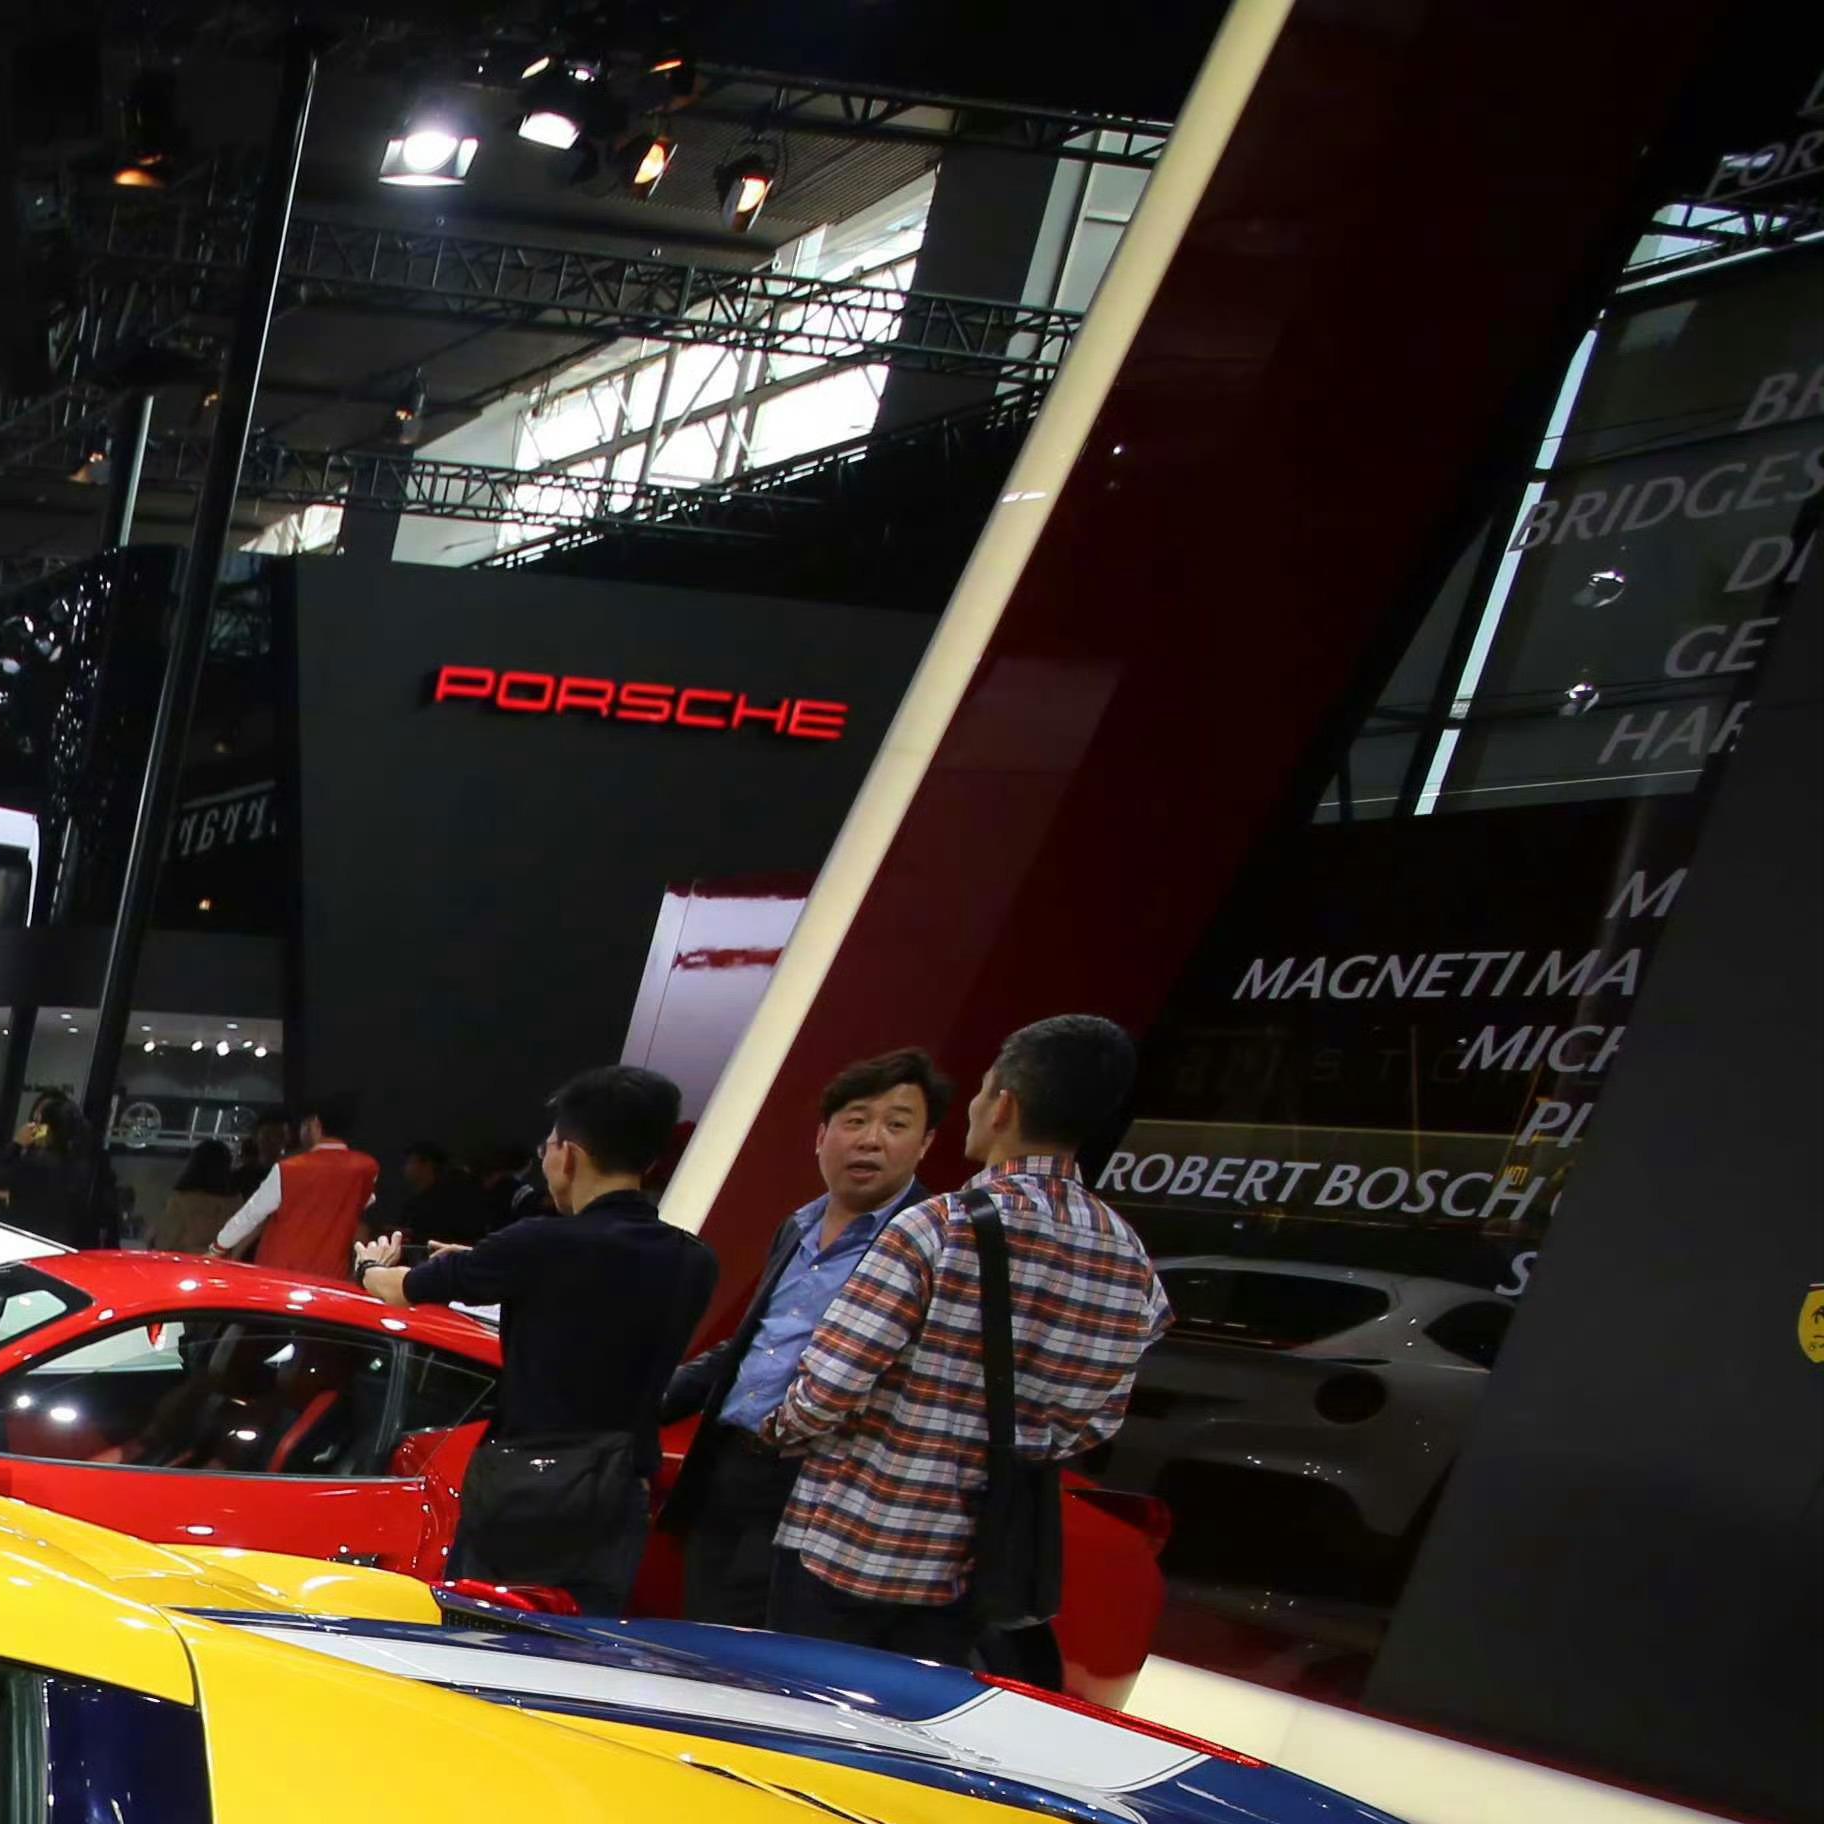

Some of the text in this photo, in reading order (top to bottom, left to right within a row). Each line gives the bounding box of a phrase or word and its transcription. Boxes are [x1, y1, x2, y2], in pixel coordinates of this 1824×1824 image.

[436, 665, 848, 740] PORSCHE
[1233, 951, 1525, 1000] MAGNETI
[1095, 1152, 1322, 1203] ROBERT
[1314, 1163, 1546, 1222] BOSCH
